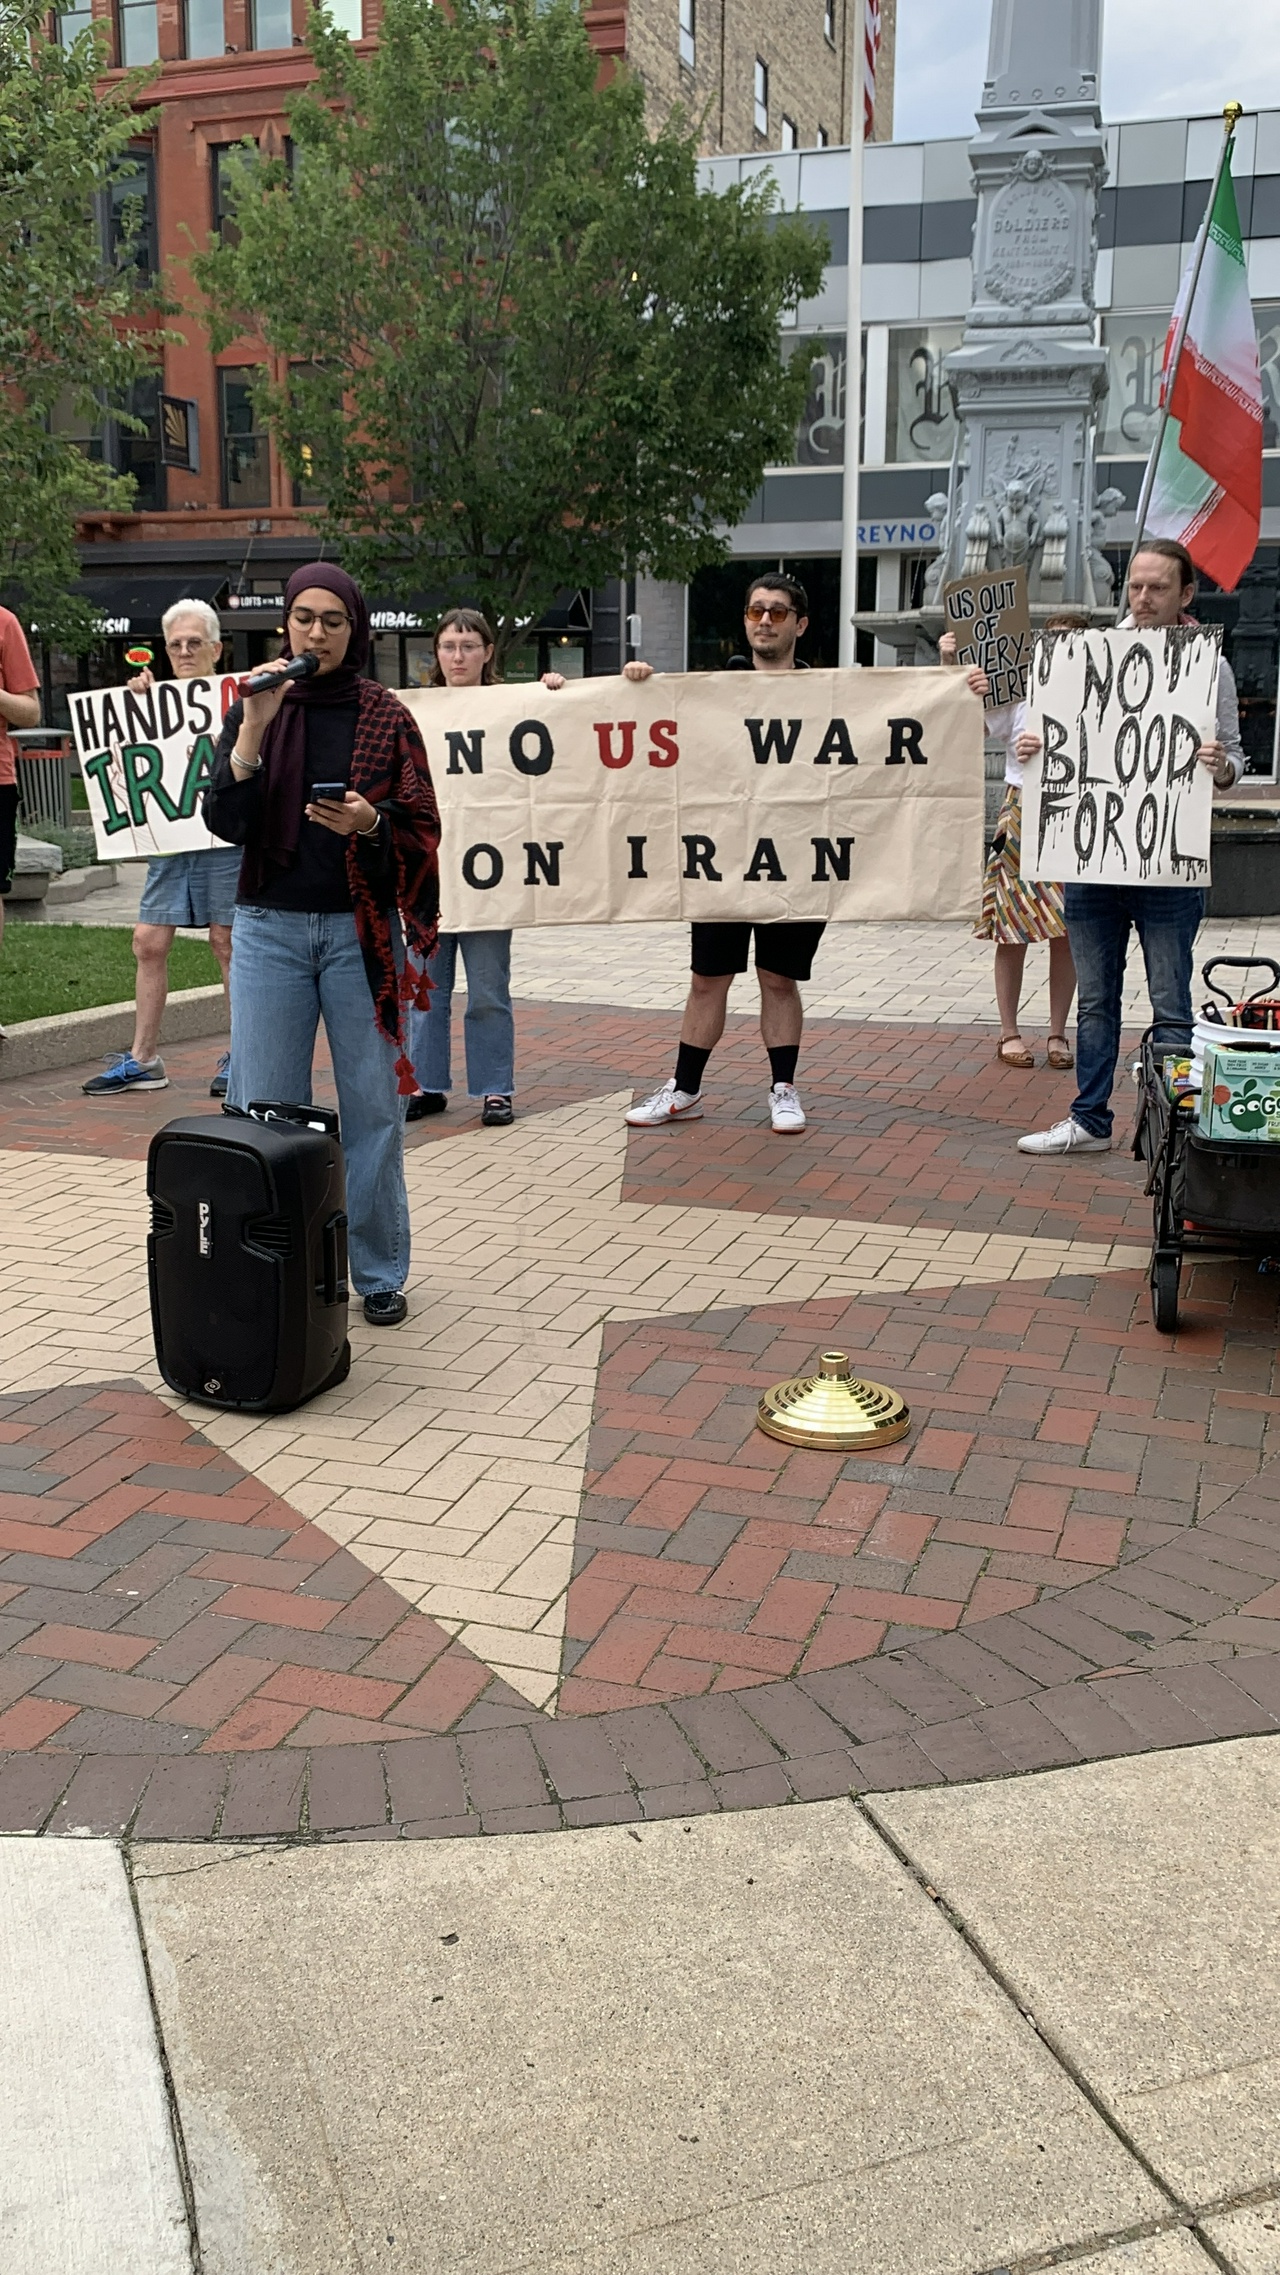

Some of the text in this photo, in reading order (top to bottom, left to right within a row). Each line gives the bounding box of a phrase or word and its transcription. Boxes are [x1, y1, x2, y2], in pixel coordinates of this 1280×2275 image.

[994, 217, 1069, 234] SOLDIERS
[947, 580, 1017, 621] US OUT
[974, 614, 999, 642] OF
[983, 663, 1028, 710] HERE
[1077, 637, 1154, 733] NO
[75, 679, 213, 752] HANDS
[445, 717, 929, 776] NO US WAR
[1041, 713, 1202, 798] BLOOD
[462, 834, 856, 890] ON IRAN
[1037, 791, 1128, 874] FOR
[1135, 791, 1208, 882] OIL
